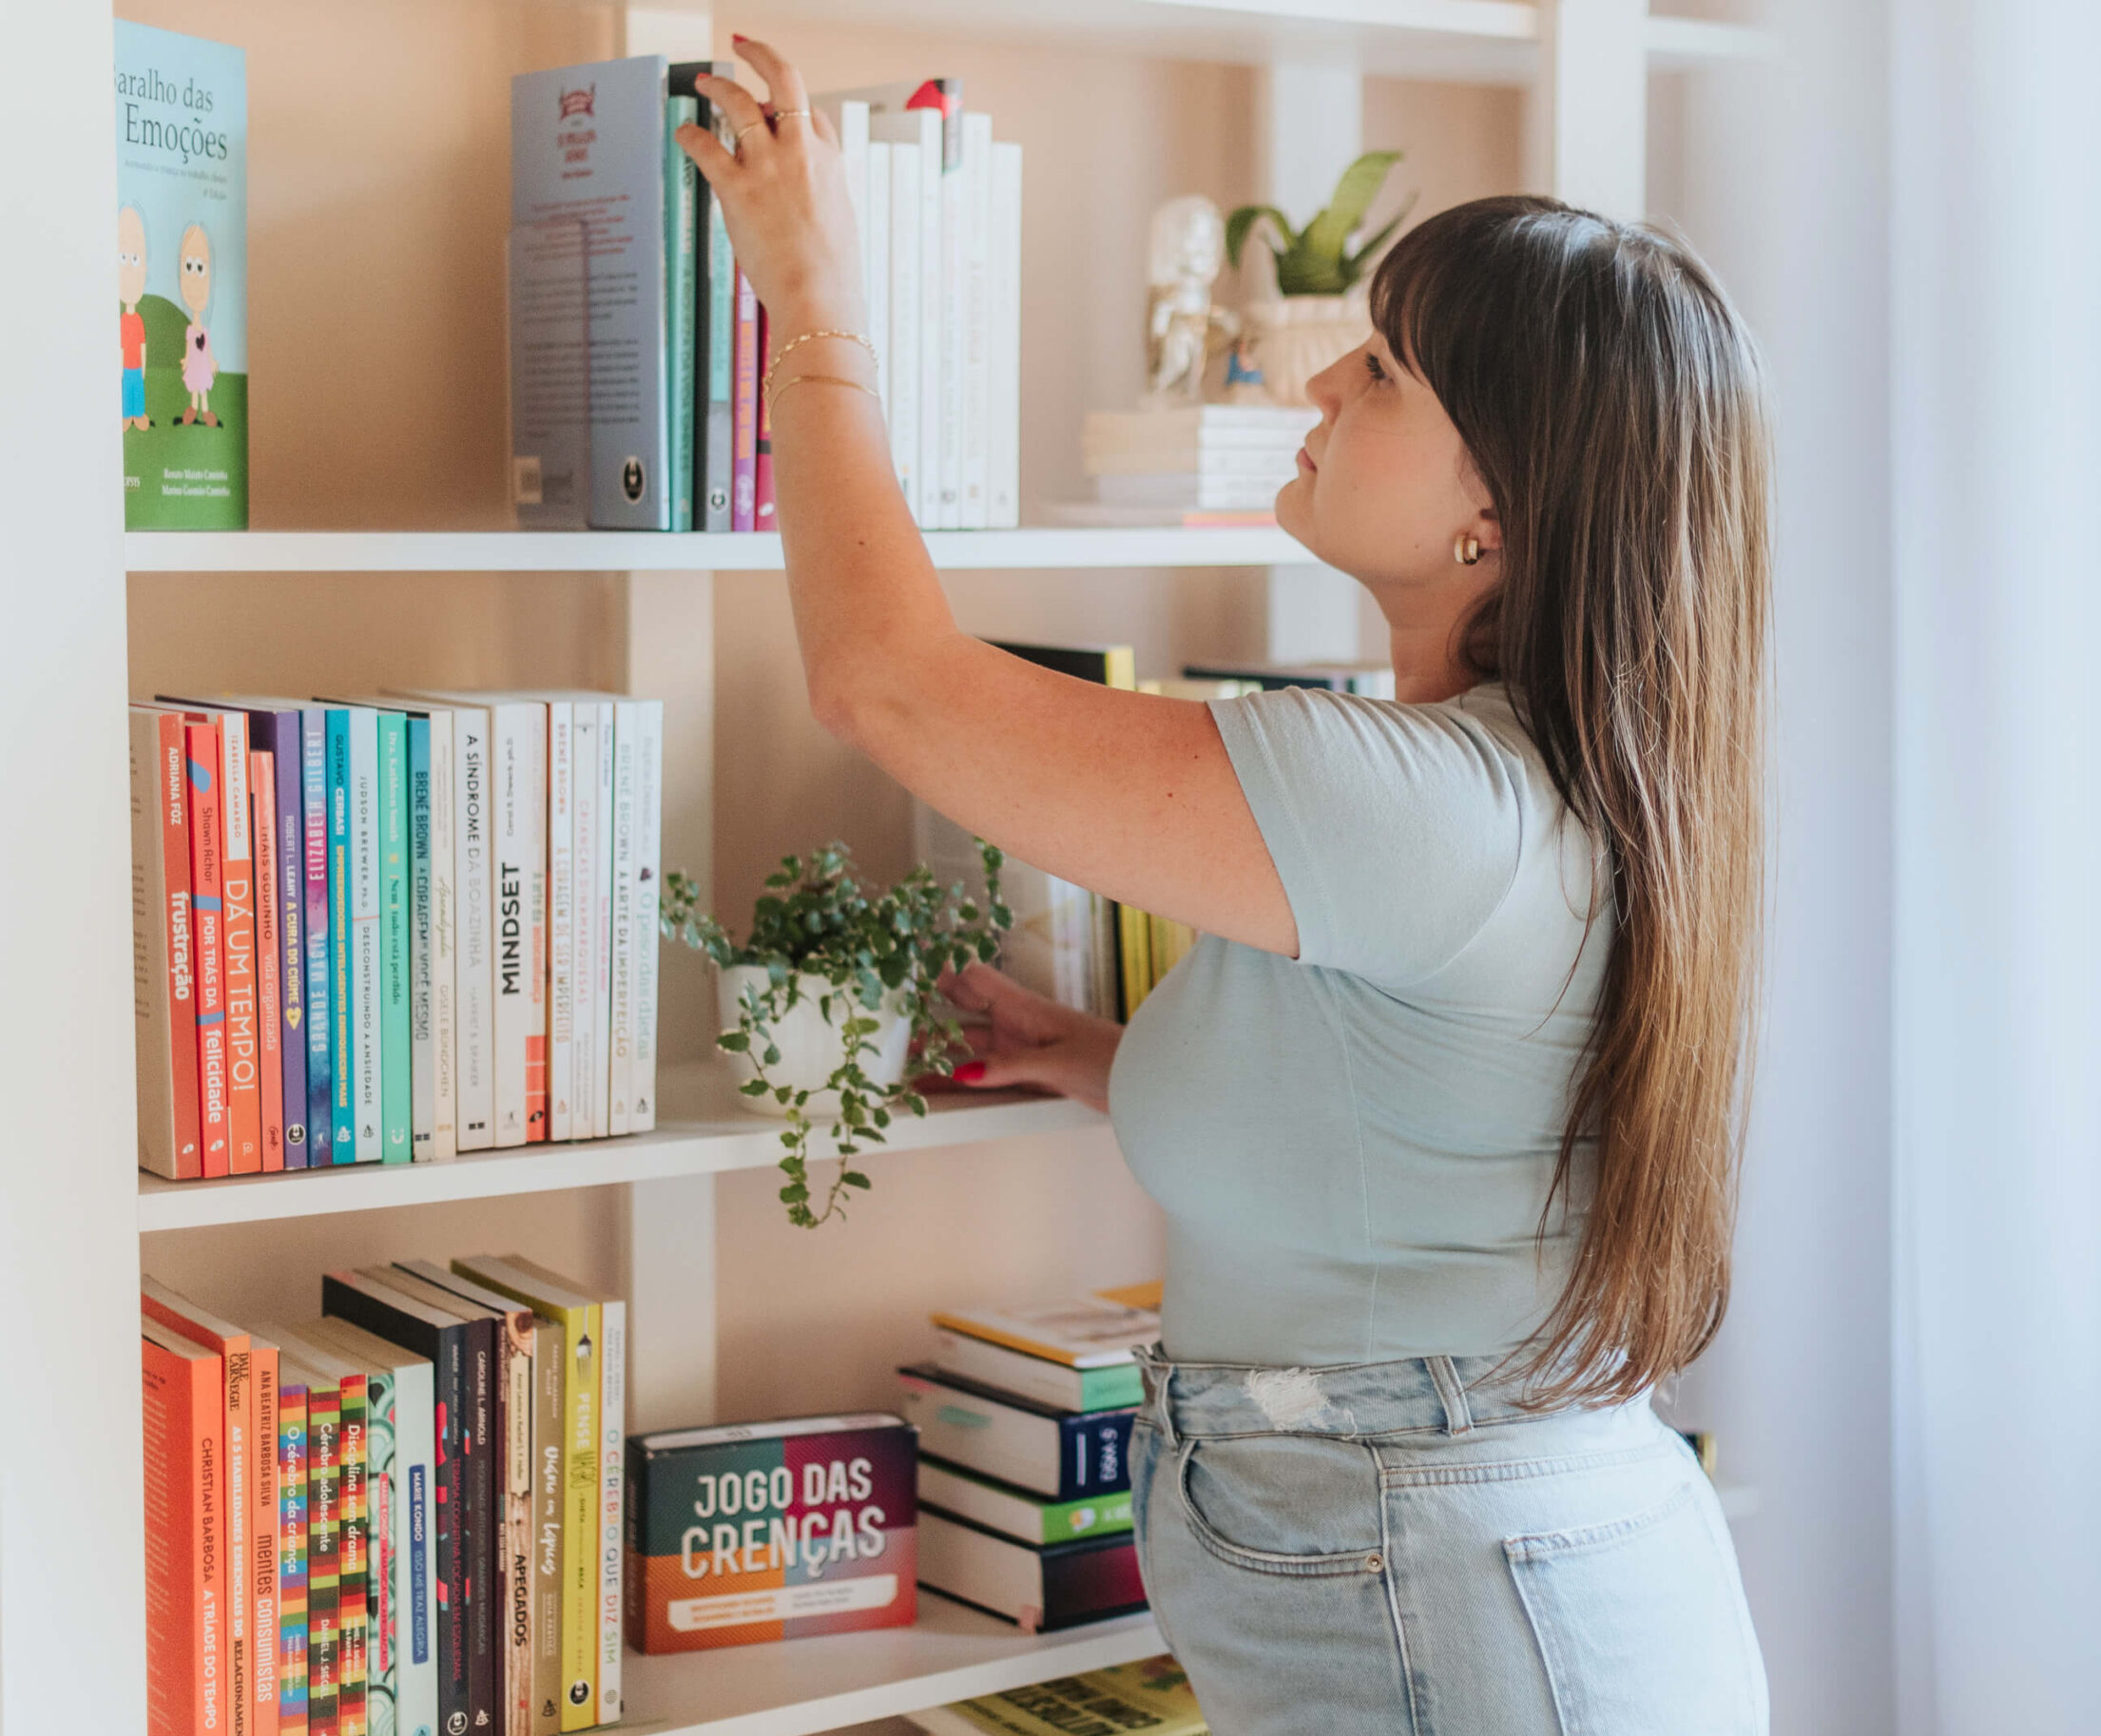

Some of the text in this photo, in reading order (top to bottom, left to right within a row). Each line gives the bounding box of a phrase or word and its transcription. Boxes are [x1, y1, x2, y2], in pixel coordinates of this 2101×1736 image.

[114, 65, 214, 112] aralho das
[125, 102, 227, 164] Emoções
[168, 746, 183, 826] ADRIANA FÓZ
[233, 787, 242, 839] CAMARGO
[306, 730, 324, 880] ELIZABETH GILBERT
[336, 734, 345, 835] GUSTAVO CERBASI
[359, 776, 369, 824] JUDSON
[415, 771, 430, 859] BRENÉ BROWN
[202, 806, 214, 883] Shawn Achor
[286, 815, 296, 852] ROBERT
[467, 734, 482, 968] A SÍNDROME DA BOAZINHA
[619, 801, 630, 861] BROWN
[260, 825, 273, 940] THAIS GODINHO
[287, 866, 297, 897] LEAHY
[416, 877, 429, 940] CORAGEM
[577, 800, 589, 1004] CRIANÇAS DINAMARQUESAS
[171, 891, 192, 1000] frustração
[203, 916, 218, 1008] POR TRÁS DA
[287, 901, 301, 1003] A CURA DO CIÚME
[416, 953, 431, 987] VOCÊ
[501, 861, 521, 995] MINDSET
[614, 871, 630, 1057] A ARTE DA IMPERFEIÇÃO
[226, 880, 255, 1091] DÁ UM TEMPO!
[262, 954, 278, 1051] vida organizada
[309, 932, 327, 1051] GRANDE MAGIA
[362, 926, 373, 1106] DESCONSTRUINDO A ANSIEDADE
[391, 963, 400, 1005] perdido
[415, 991, 429, 1041] MESMO
[637, 892, 654, 1061] O peso das dietas
[206, 1030, 223, 1123] felicidade
[439, 985, 451, 1098] GISELE BÜNDCHEN
[229, 1353, 240, 1411] CARNEGIE
[239, 1352, 249, 1381] DALE
[477, 1351, 486, 1396] CAROLINE
[233, 1426, 242, 1441] AS
[260, 1371, 271, 1507] ANA BEATRIZ BARBOSA SILVA
[477, 1406, 487, 1445] ARNOLD
[576, 1392, 591, 1449] PENSE
[202, 1437, 214, 1583] CHRISTIAN BARBOSA
[233, 1456, 242, 1541] HABILIDADES
[284, 1426, 299, 1573] O cérebro da criança
[319, 1422, 333, 1552] Cérebro adolescente
[344, 1424, 359, 1571] Disciplina sem drama
[414, 1472, 423, 1542] MARIE KONDO
[694, 1457, 873, 1518] JOGO DAS
[234, 1546, 243, 1616] ESSENCIAIS
[605, 1429, 623, 1665] O CÉREBRO QUE DIZ SIM
[681, 1506, 886, 1580] CRENÇAS
[234, 1619, 243, 1637] DO
[257, 1534, 275, 1702] mentes consumistas
[320, 1619, 329, 1654] DANIEL
[414, 1550, 425, 1656] ISSO ME TRAZ ALEGRIA
[514, 1554, 527, 1647] APEGADOS
[202, 1590, 218, 1728] A TRÍADE DO TEMPO
[320, 1666, 330, 1700] SIEGEL
